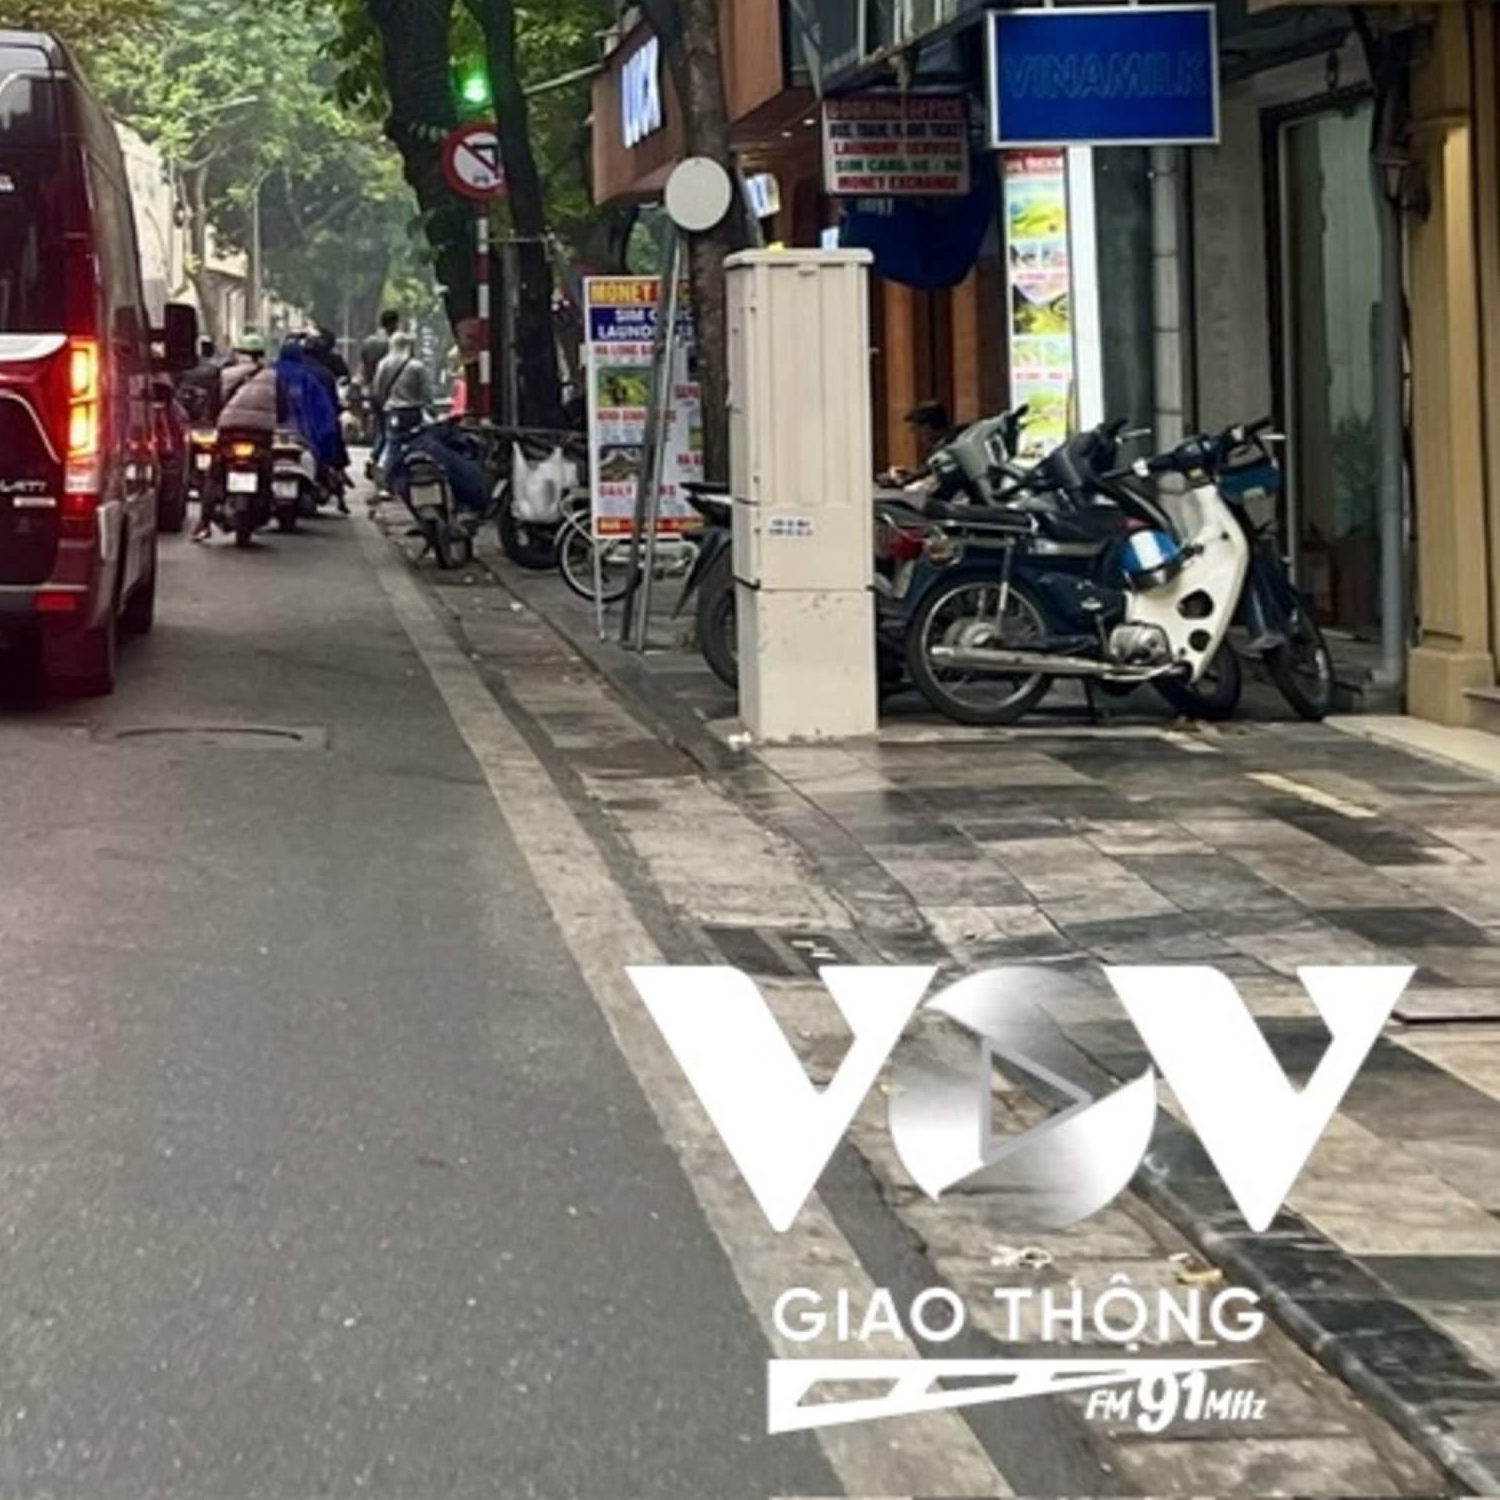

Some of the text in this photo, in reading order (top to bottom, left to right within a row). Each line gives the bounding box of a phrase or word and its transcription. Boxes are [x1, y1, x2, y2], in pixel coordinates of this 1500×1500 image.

[1002, 51, 1206, 99] VINAMILK
[838, 175, 959, 190] MONEY EXCHANGE
